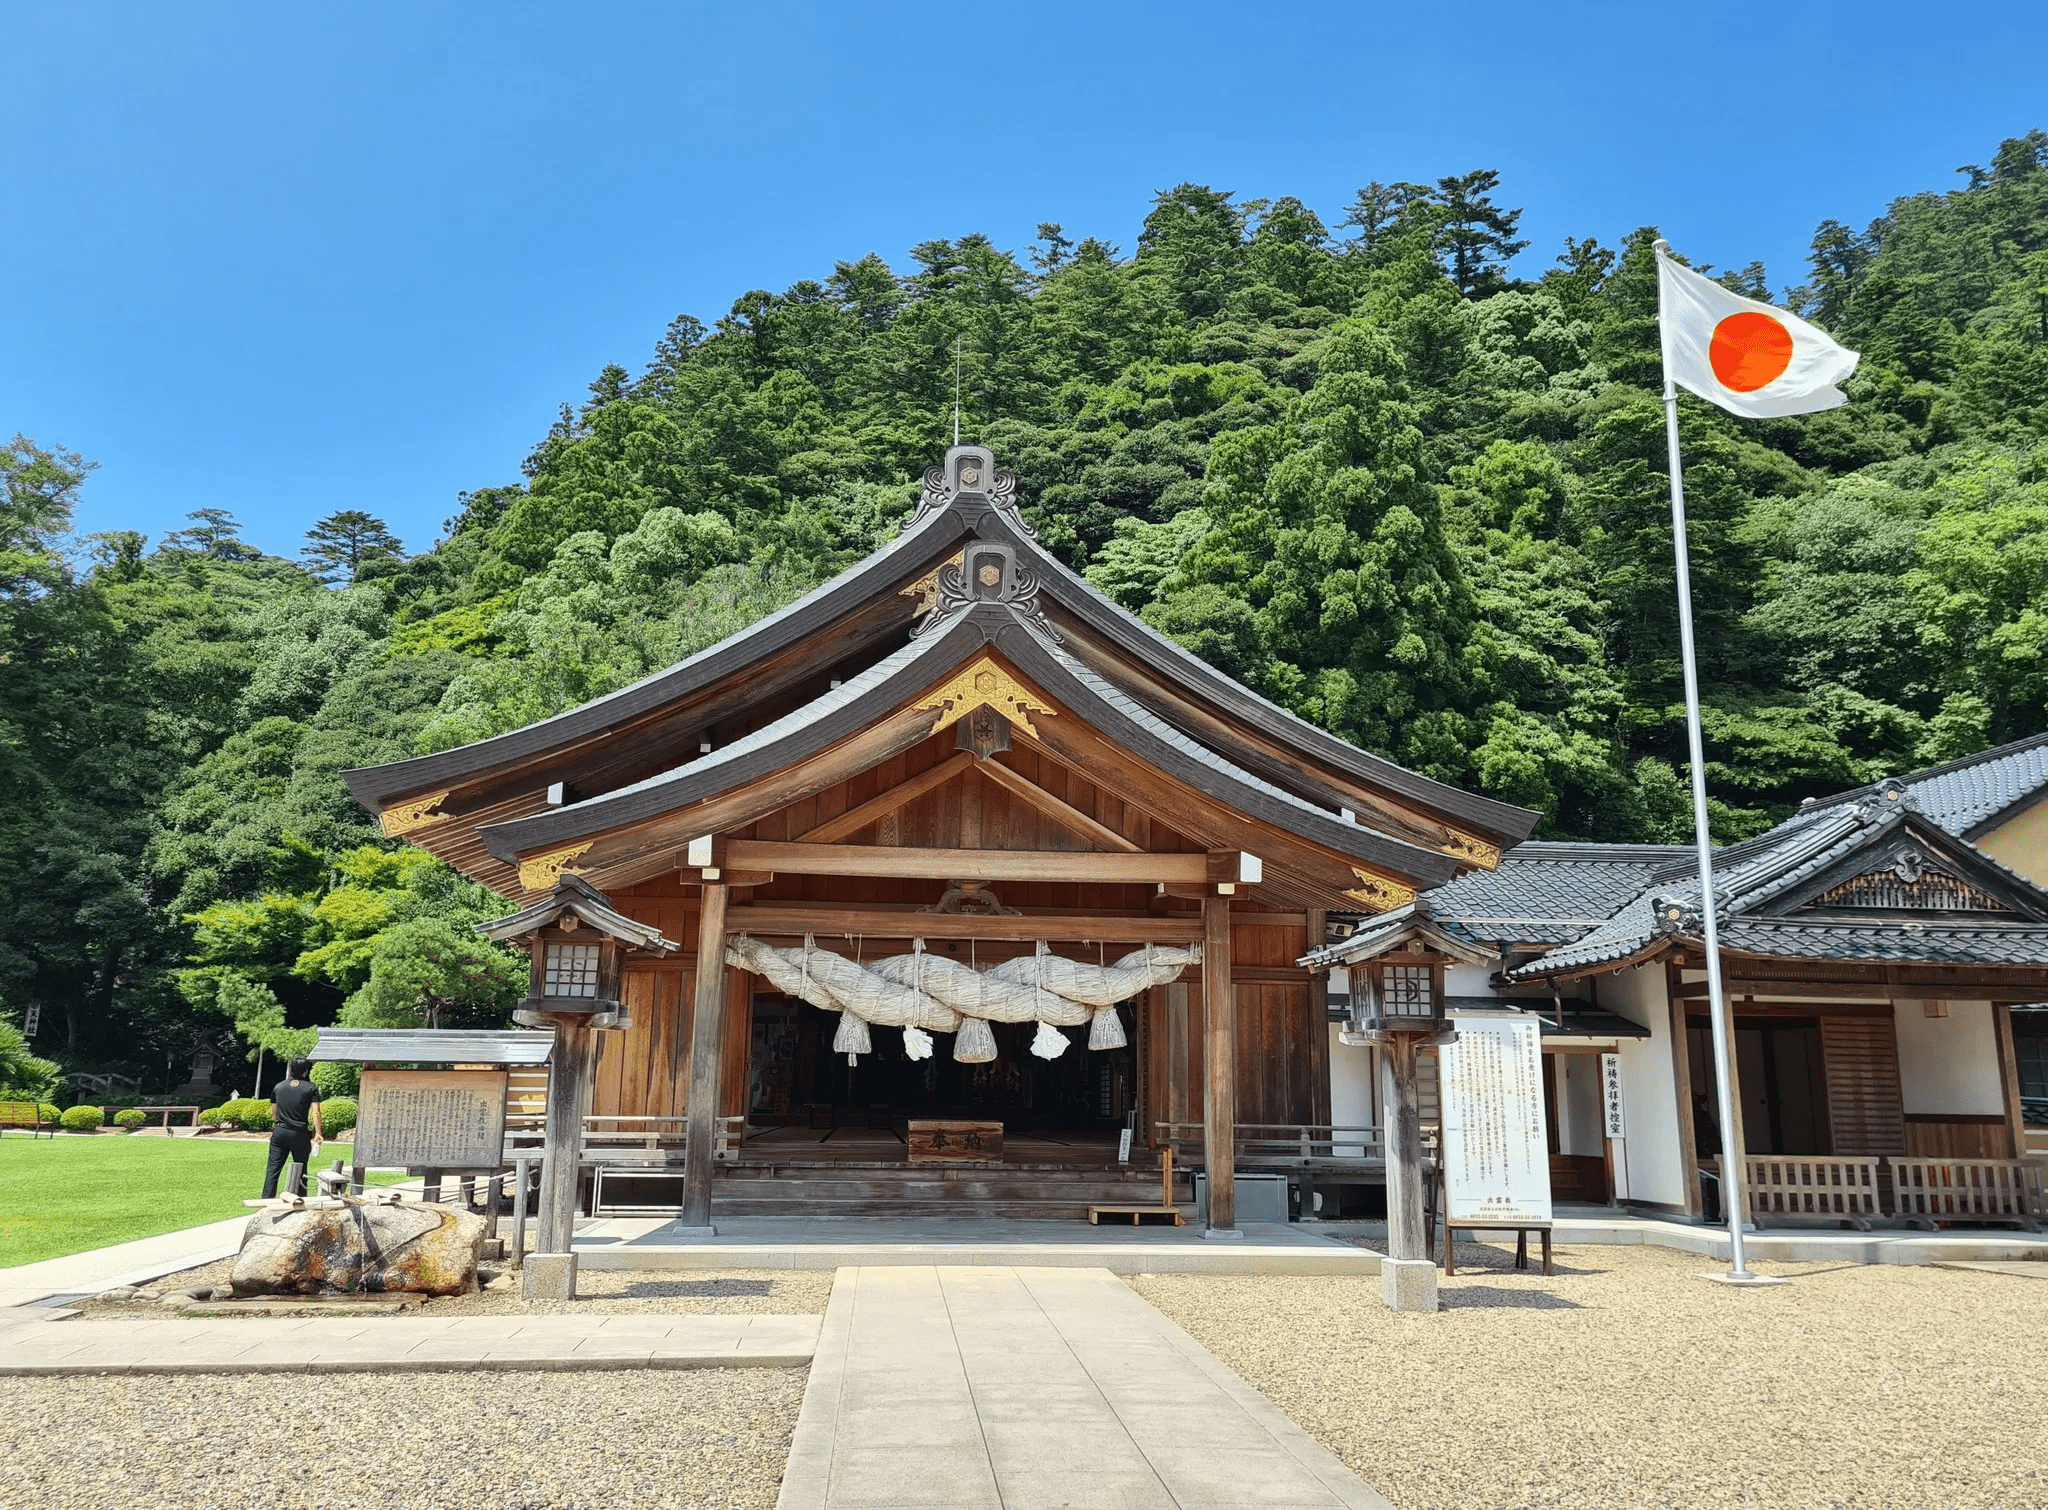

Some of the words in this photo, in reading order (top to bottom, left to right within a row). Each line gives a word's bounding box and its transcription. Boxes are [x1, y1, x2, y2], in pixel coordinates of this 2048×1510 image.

[1606, 1057, 1621, 1134] 祈祷参拝者控室
[929, 1128, 983, 1151] 奉納
[1487, 1196, 1512, 1204] 出雲教
